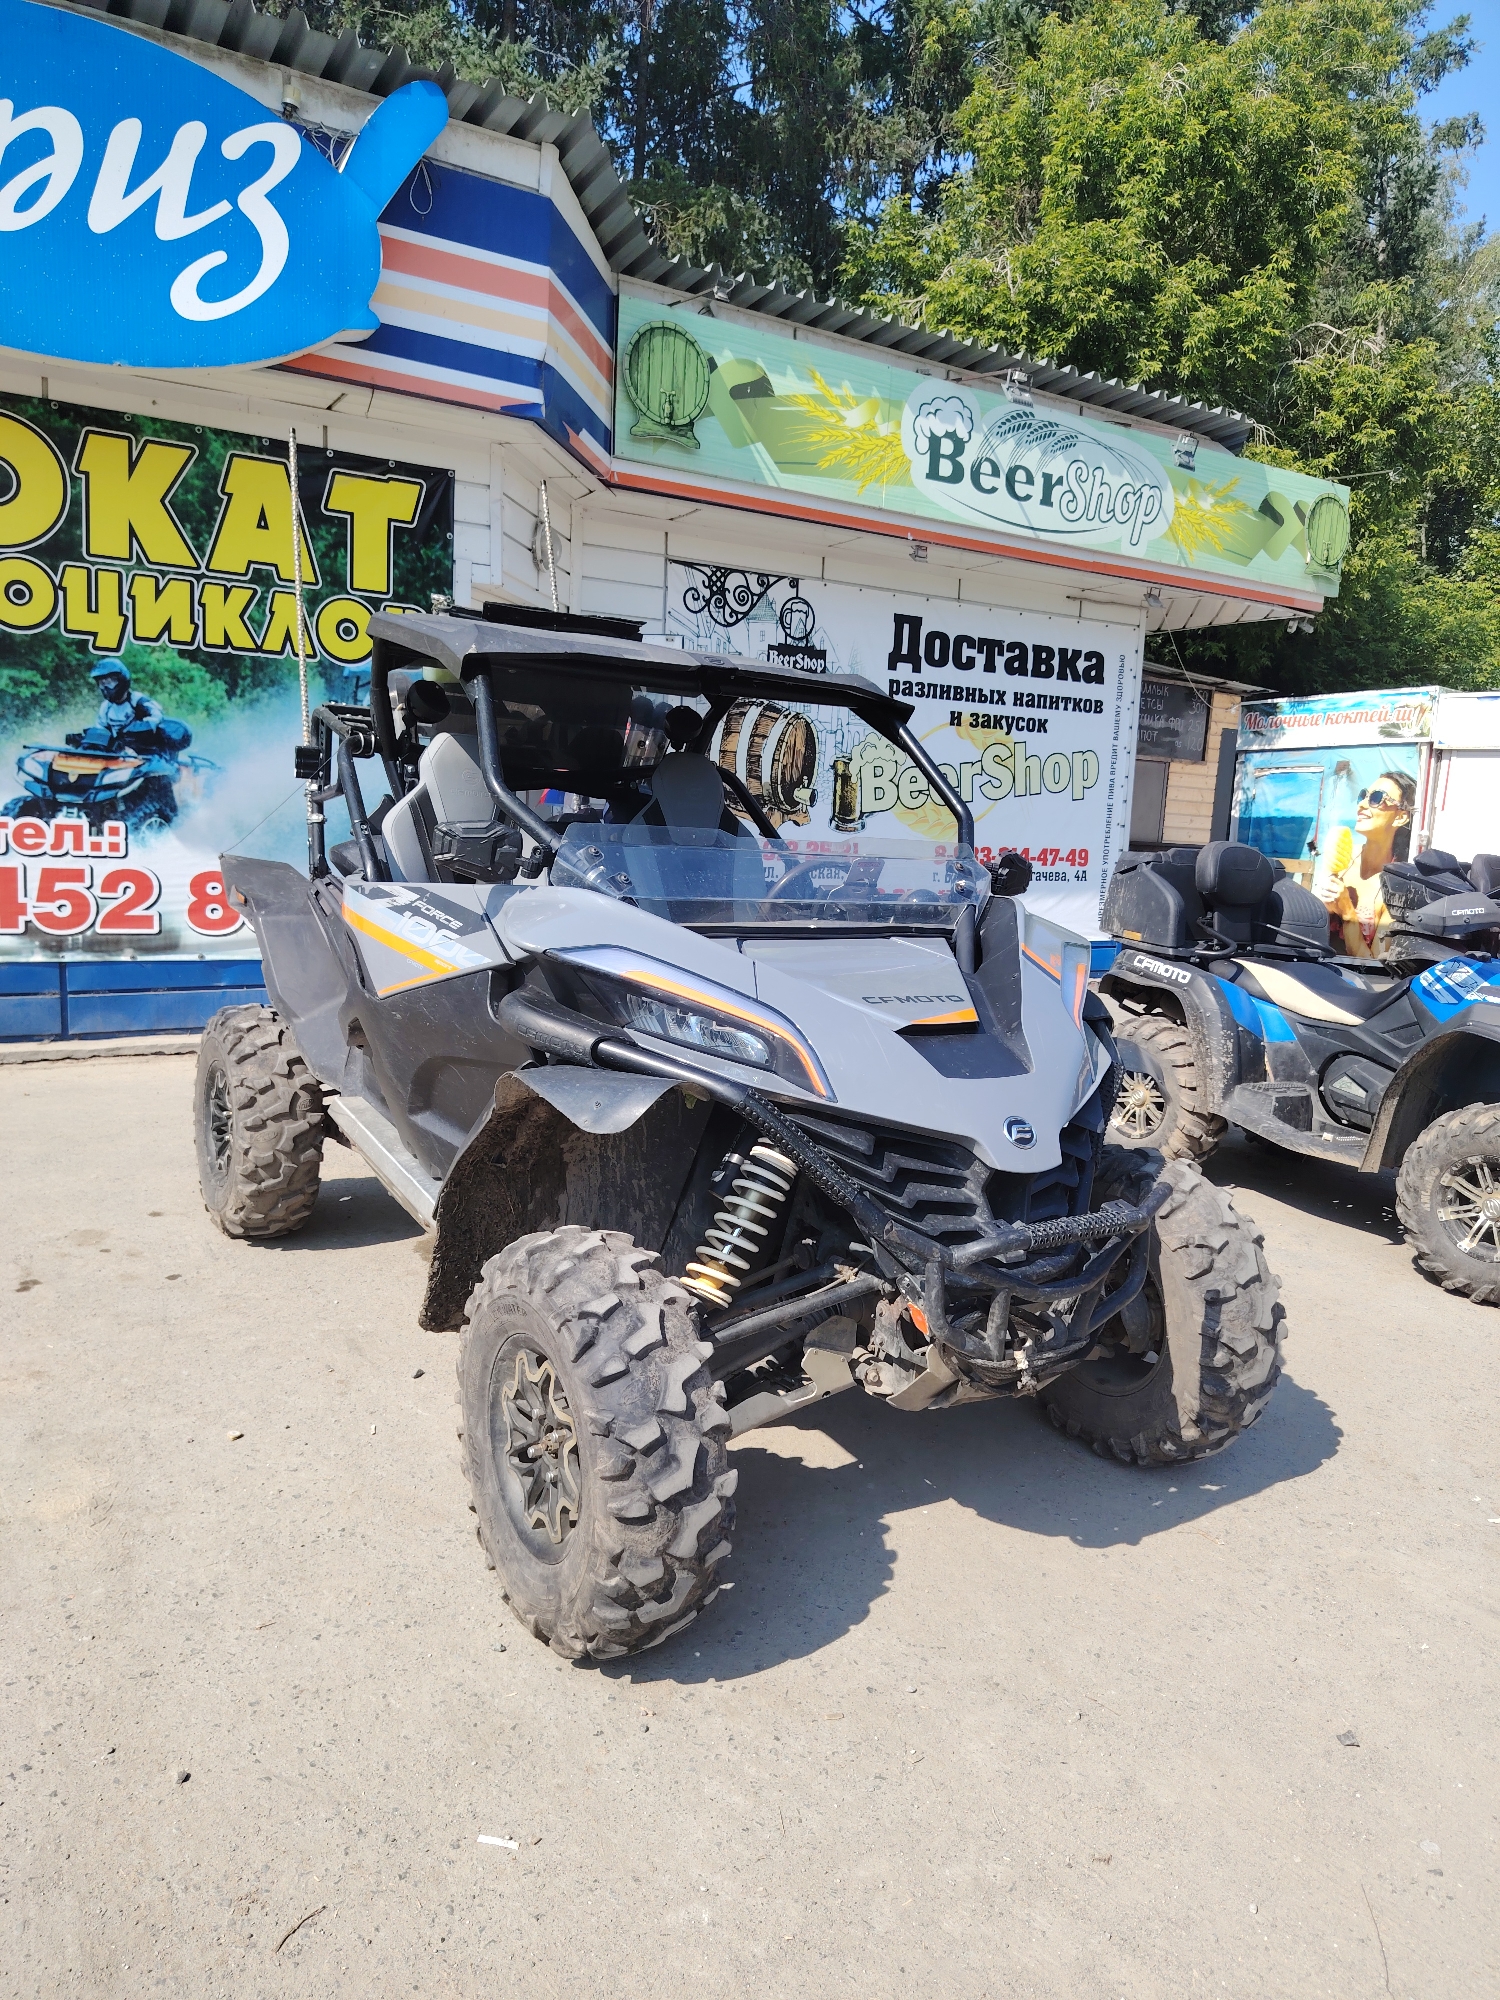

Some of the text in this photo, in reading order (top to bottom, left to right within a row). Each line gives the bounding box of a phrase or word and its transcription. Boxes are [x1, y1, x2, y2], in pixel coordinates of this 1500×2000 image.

[925, 426, 1163, 546] BeerShop
[0, 556, 424, 663] ОЦИКЛО
[769, 649, 825, 674] BeerShop
[887, 612, 1105, 686] Доставка
[1116, 654, 1127, 702] ЗДОРОВЬЮ
[888, 678, 1104, 714] разливных напитков
[949, 710, 1049, 736] и закусок
[1112, 705, 1123, 742] ВАШЕМУ
[1244, 705, 1414, 731] Молочные коктейли
[1137, 730, 1158, 742] ПОТ
[859, 740, 1100, 813] BeerShop
[1109, 744, 1119, 777] ВРЕДИТ
[1107, 777, 1116, 801] ПИВА
[1101, 803, 1114, 866] УПОТРЕБЛЕНИЕ
[187, 869, 243, 932] 8
[411, 899, 464, 931] FORCE
[1133, 955, 1192, 984] CFMOTO
[861, 994, 965, 1005] CFMOTO
